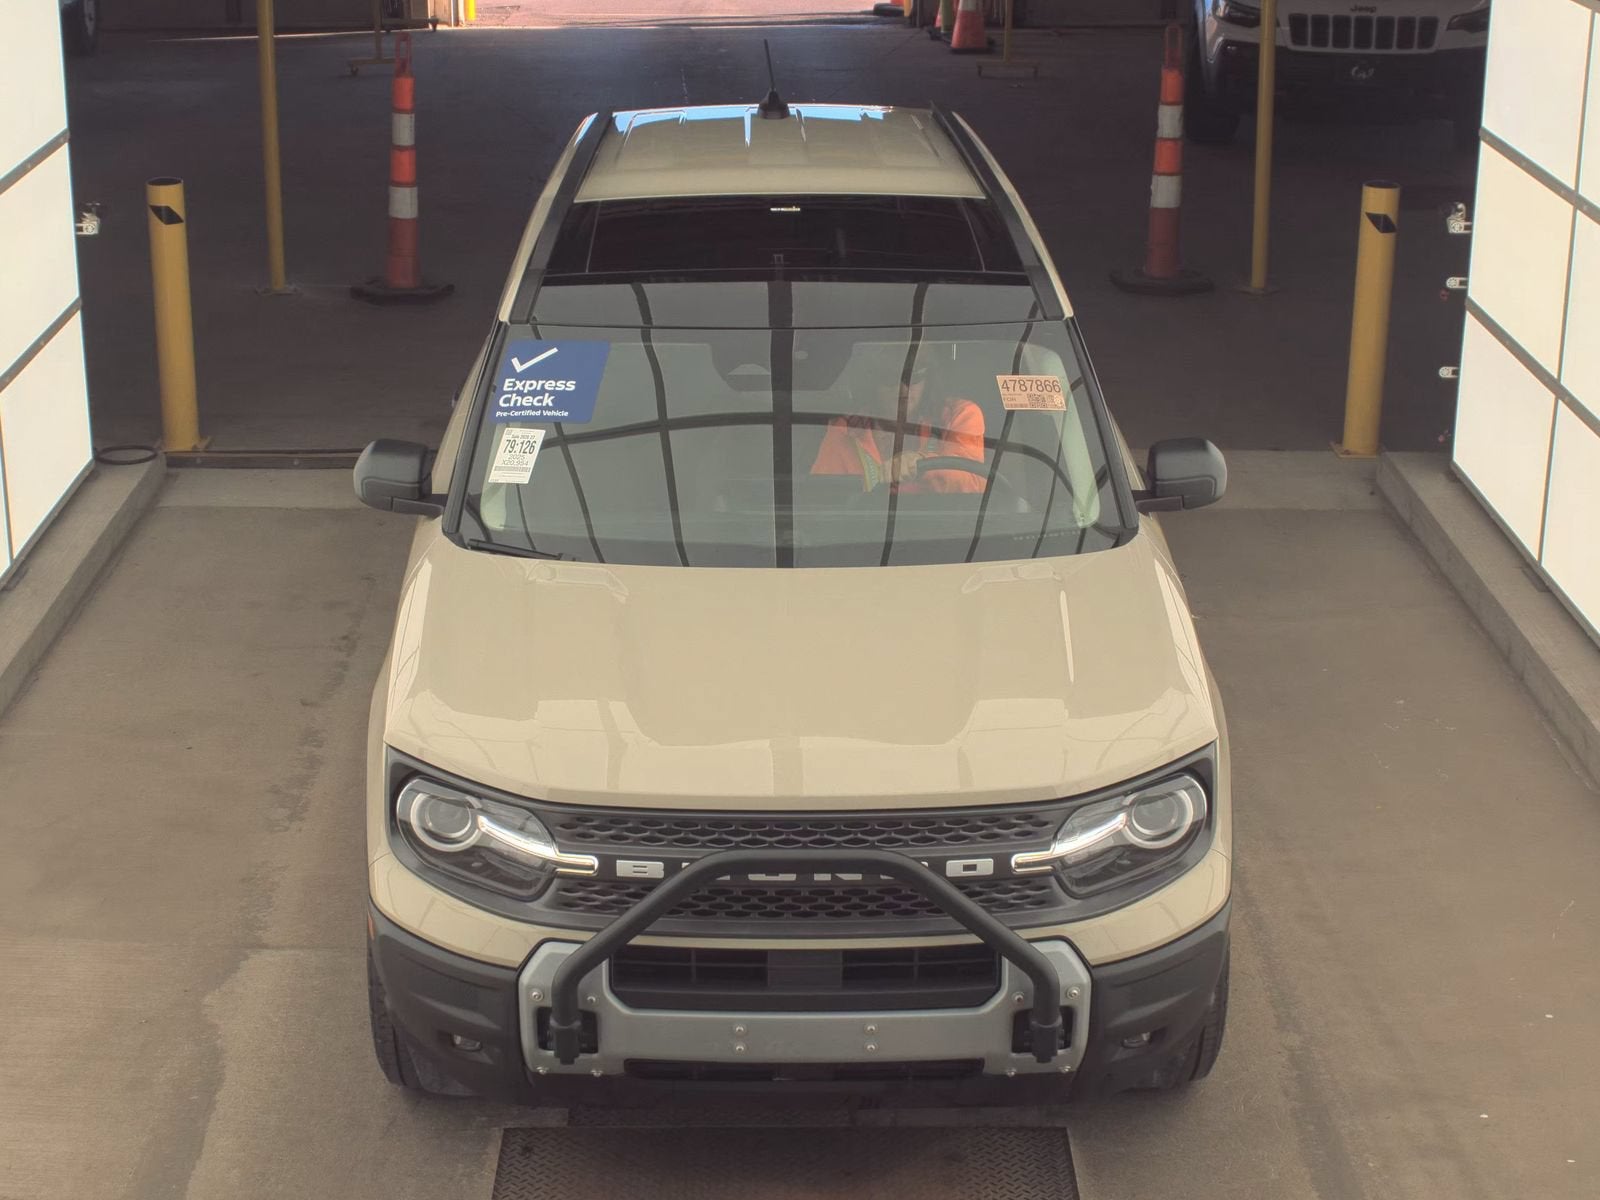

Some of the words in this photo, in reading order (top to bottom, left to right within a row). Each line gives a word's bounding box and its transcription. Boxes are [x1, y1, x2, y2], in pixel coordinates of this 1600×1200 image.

[1349, 4, 1377, 14] Jeep
[503, 378, 576, 393] Express
[1001, 379, 1061, 393] 4787866
[498, 393, 555, 407] Check
[504, 439, 536, 454] 79:126
